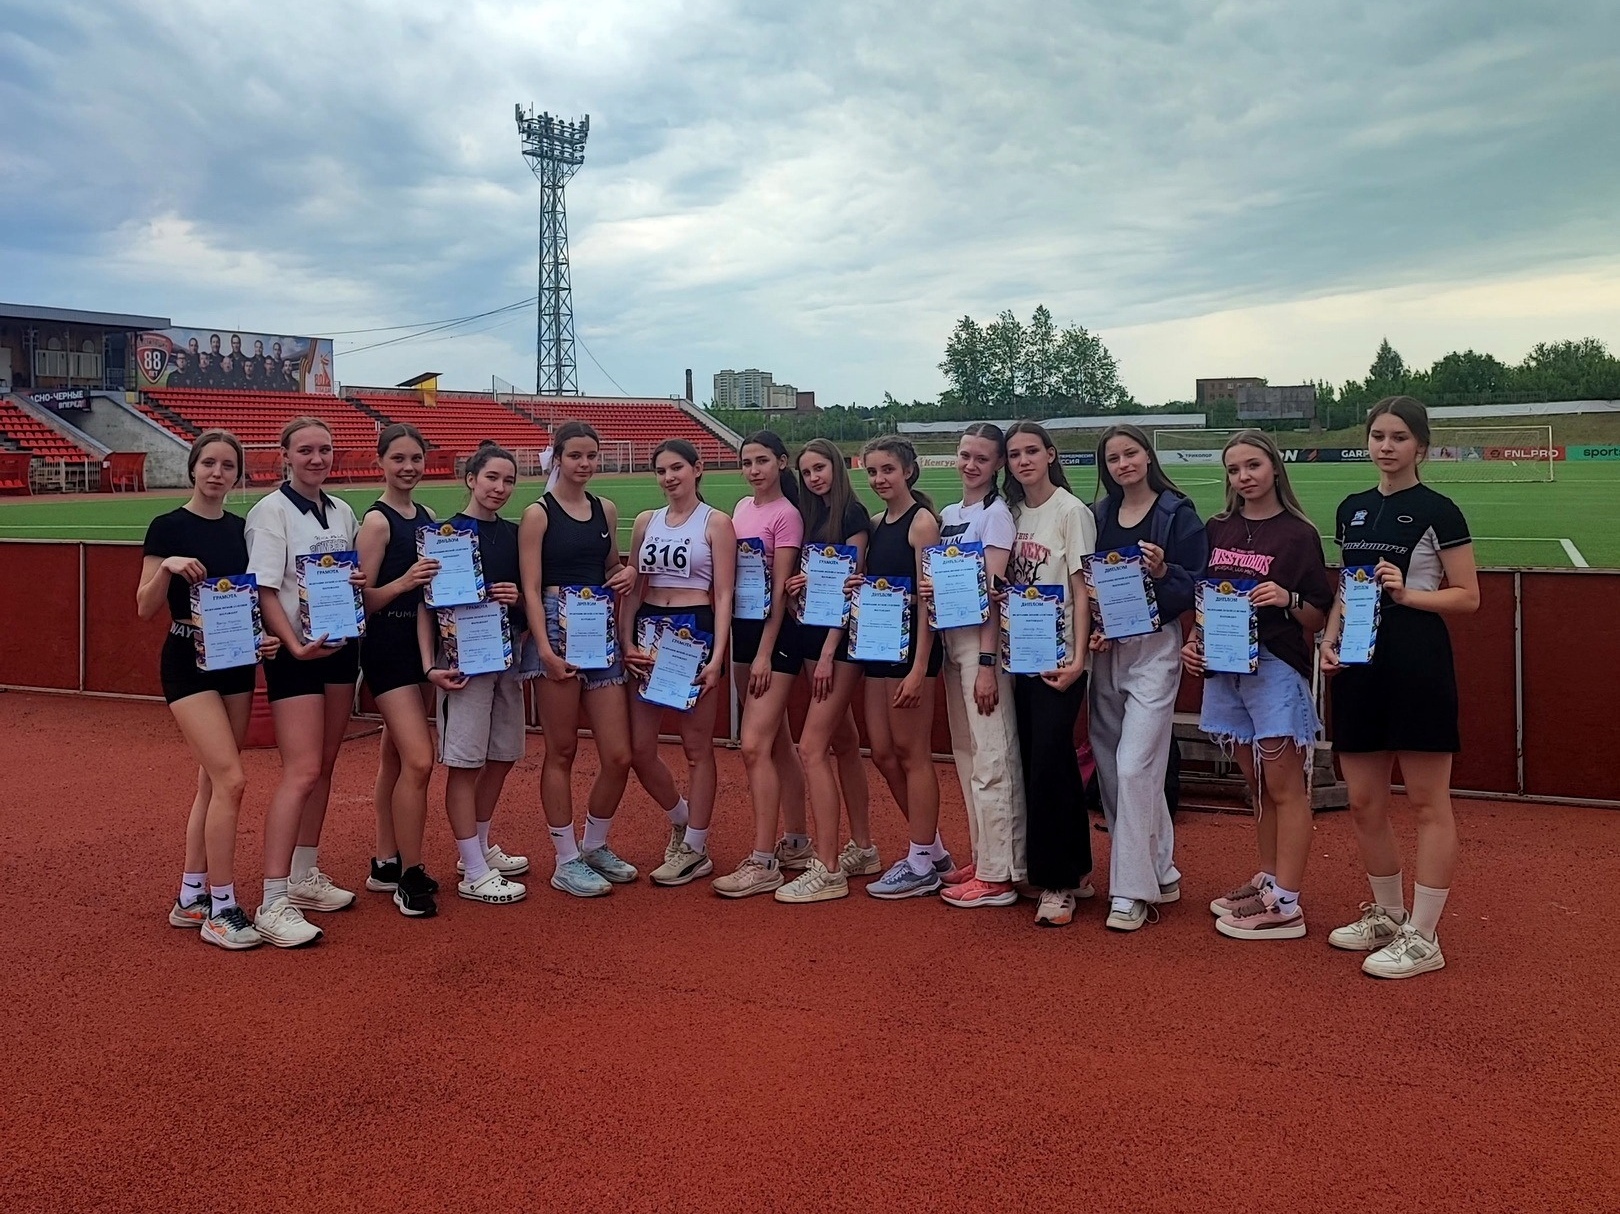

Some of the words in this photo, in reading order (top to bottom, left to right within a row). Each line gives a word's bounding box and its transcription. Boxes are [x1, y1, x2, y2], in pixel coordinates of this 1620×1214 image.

[144, 351, 161, 370] 88
[643, 544, 687, 569] 316
[482, 894, 513, 902] crocs
